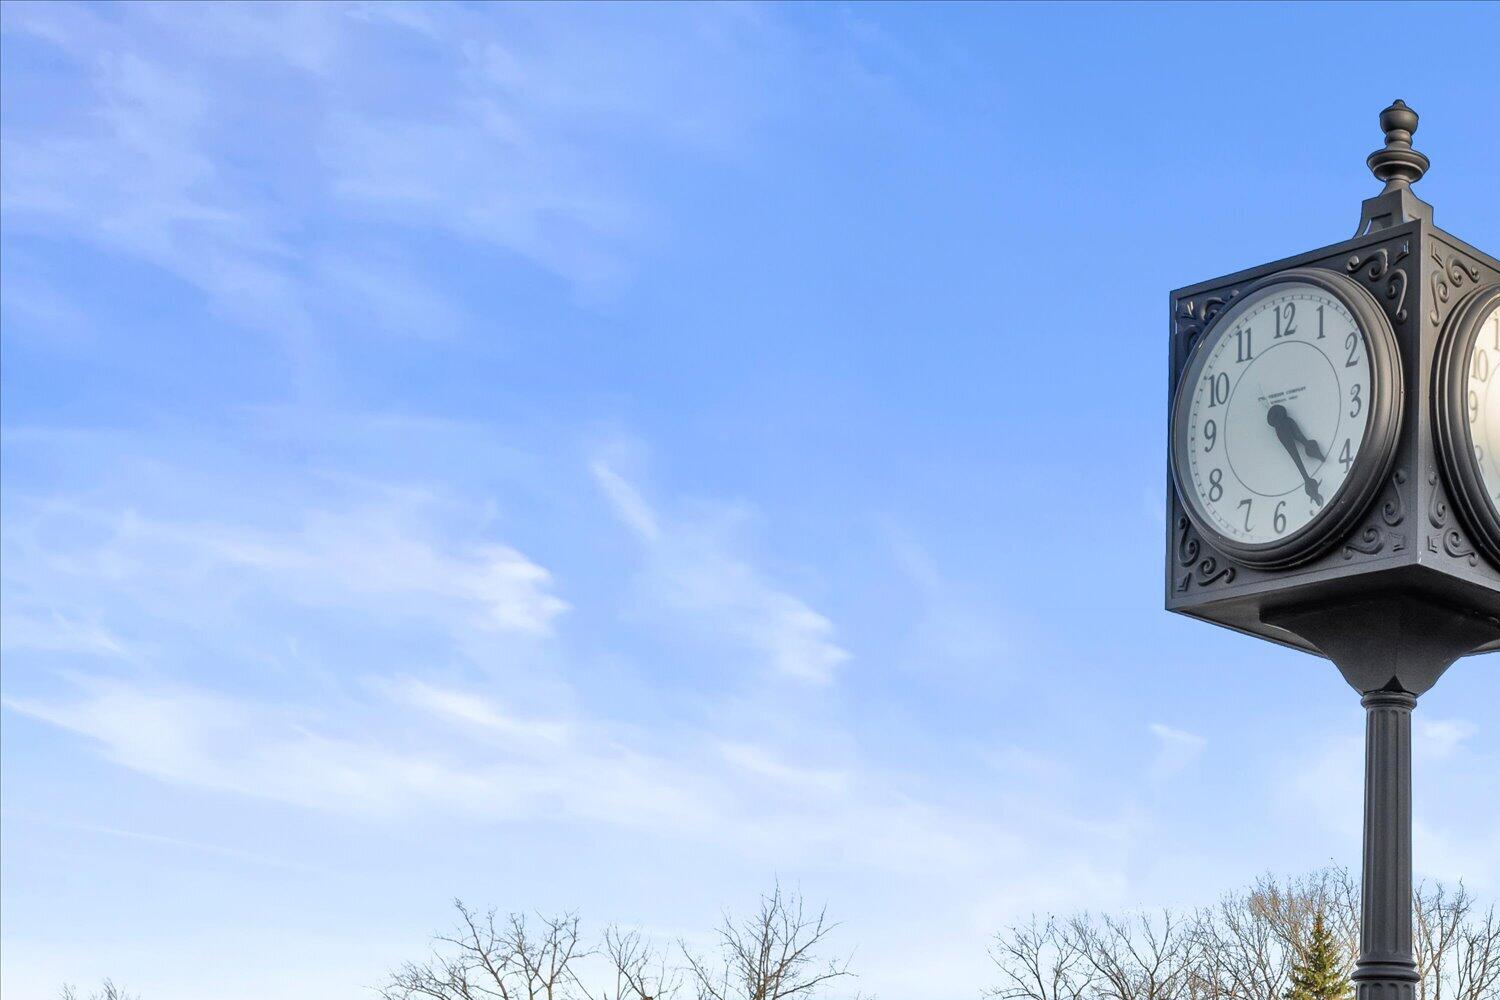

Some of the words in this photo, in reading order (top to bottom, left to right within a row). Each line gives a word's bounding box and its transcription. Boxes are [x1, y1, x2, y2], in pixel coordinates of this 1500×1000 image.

[1273, 302, 1298, 340] 12
[1316, 305, 1326, 340] 1
[1236, 327, 1254, 364] 11
[1345, 332, 1359, 368] 2
[1207, 372, 1230, 409] 10
[1350, 383, 1361, 418] 3
[1469, 391, 1478, 423] 9
[1204, 419, 1217, 453] 9
[1339, 438, 1353, 473] 4
[1209, 468, 1223, 503] 8
[1237, 498, 1253, 532] 7
[1274, 500, 1287, 534] 6
